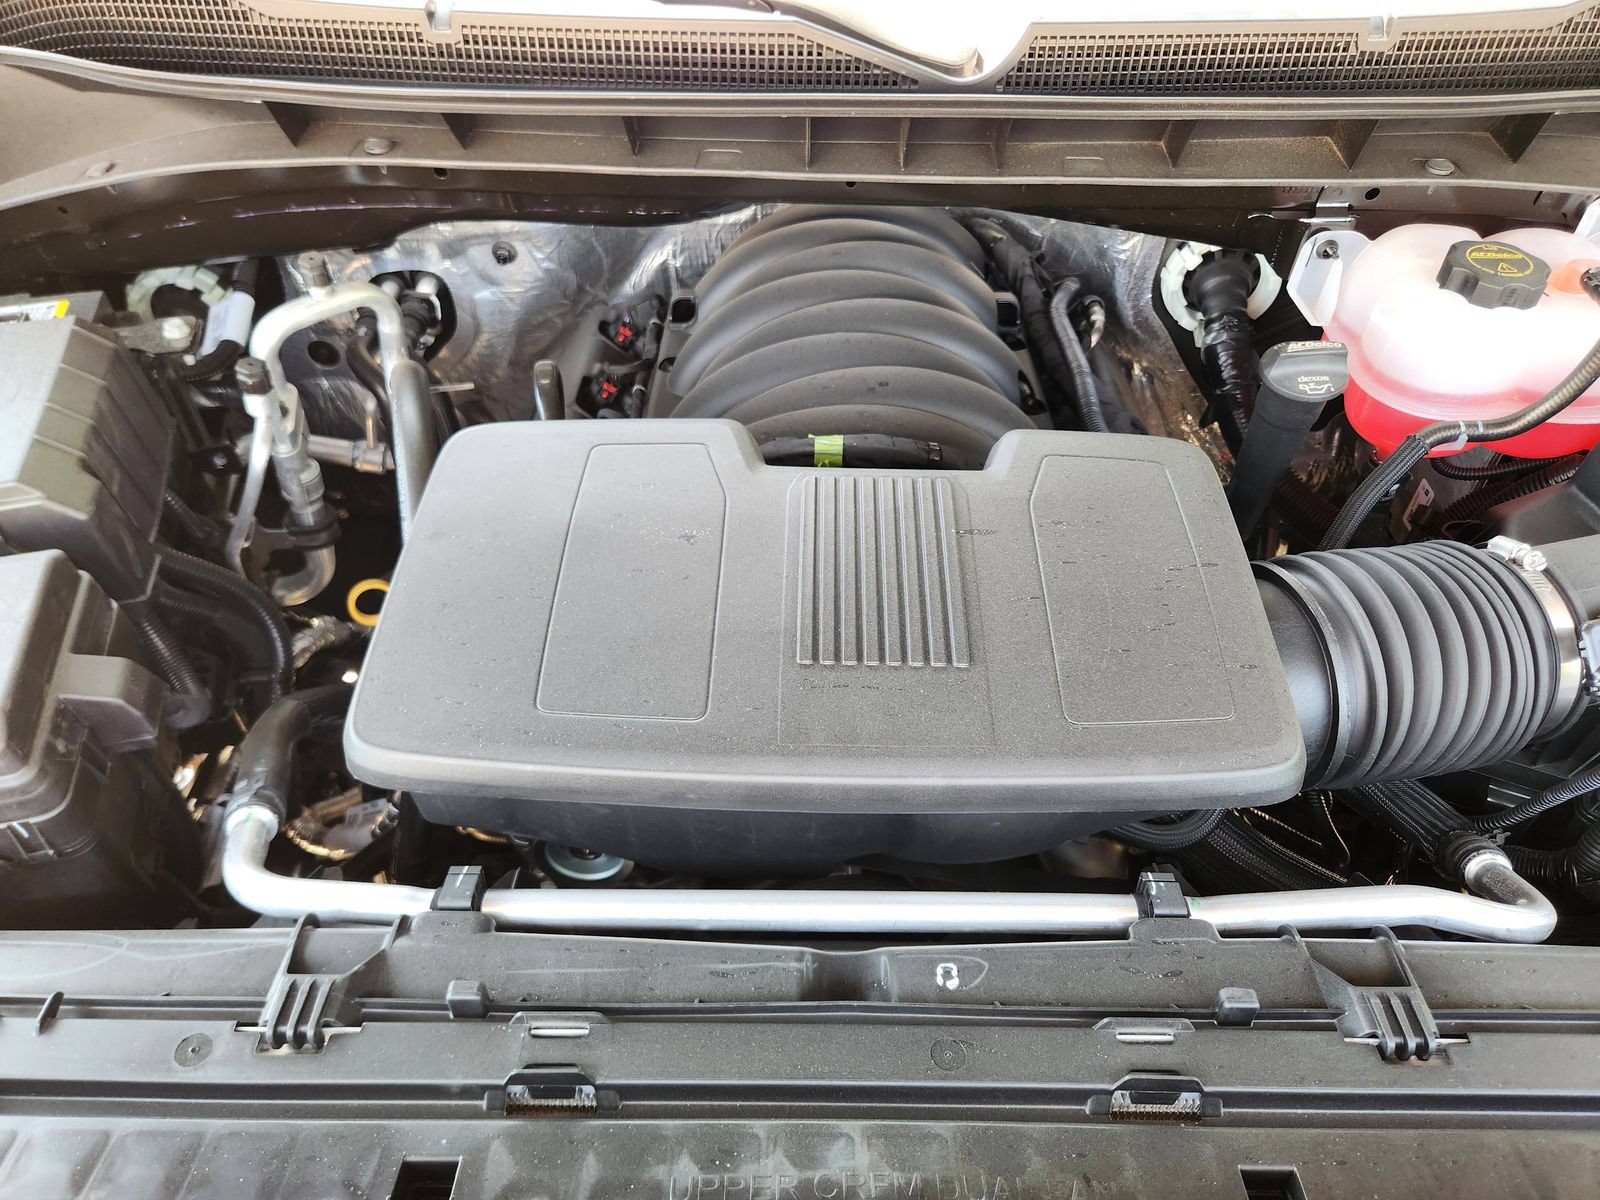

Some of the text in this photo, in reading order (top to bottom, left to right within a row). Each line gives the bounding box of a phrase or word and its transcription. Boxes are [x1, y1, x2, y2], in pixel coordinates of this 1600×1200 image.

[1468, 251, 1525, 261] ACDelco
[1287, 340, 1343, 352] ACDelco
[1297, 375, 1330, 383] dexos
[669, 1174, 801, 1200] UPPER
